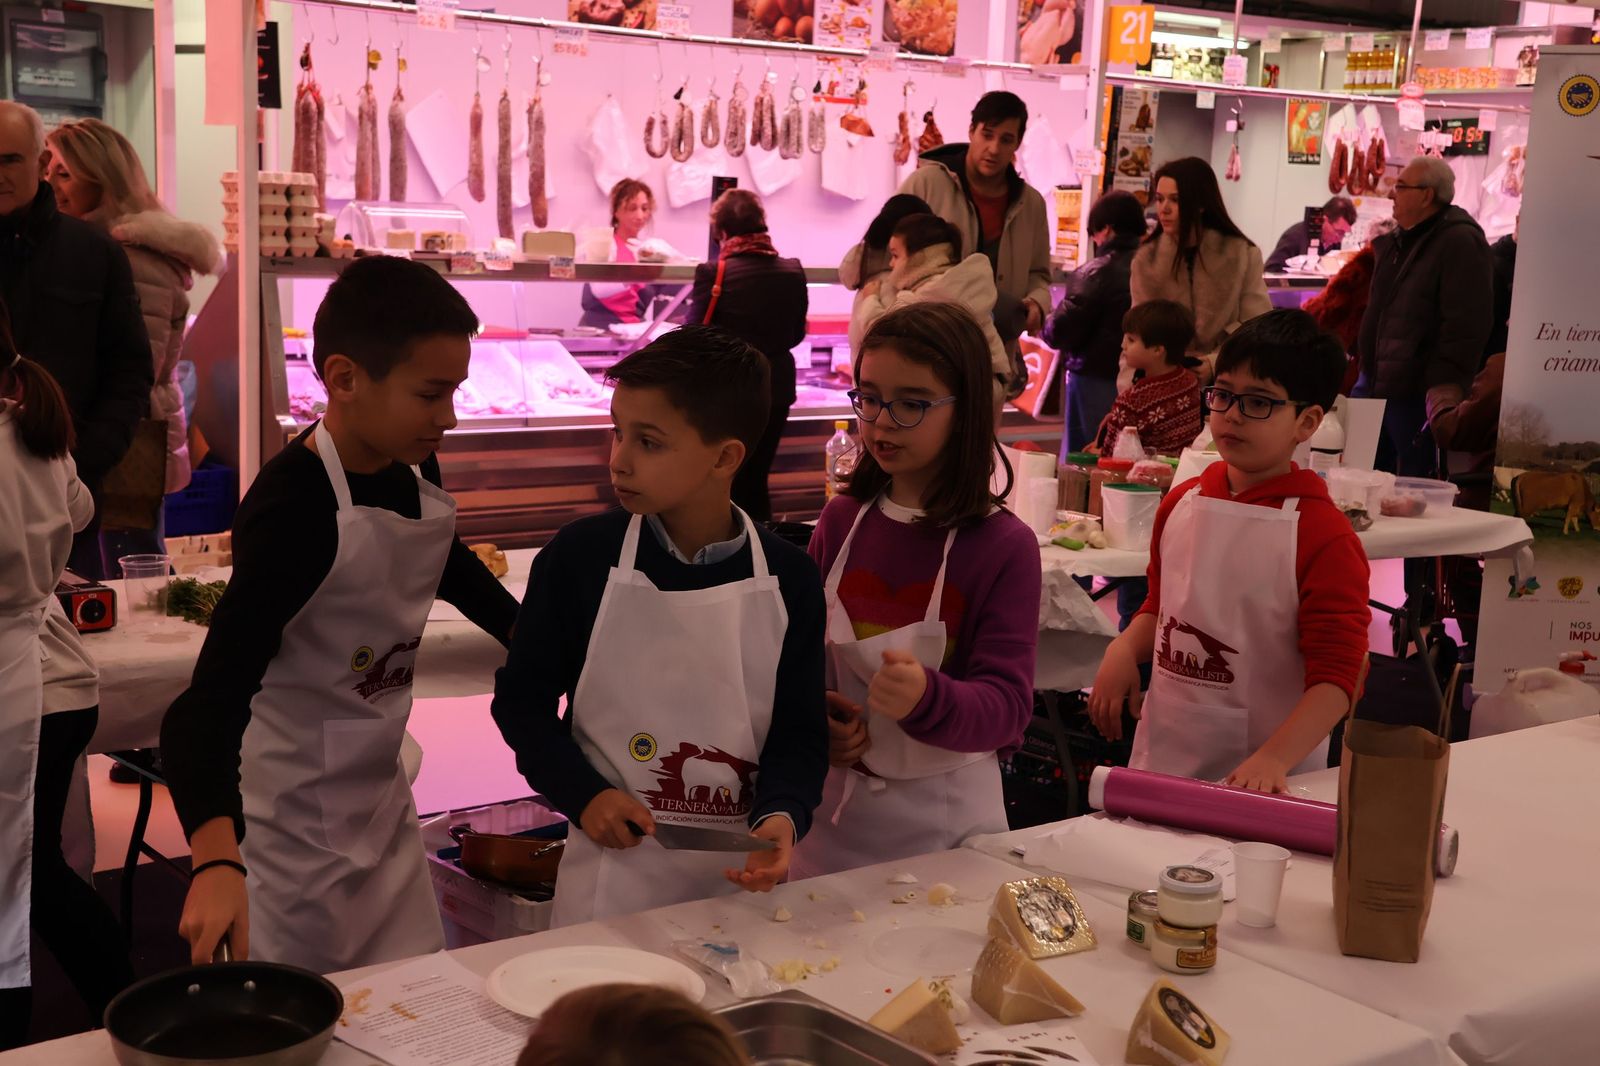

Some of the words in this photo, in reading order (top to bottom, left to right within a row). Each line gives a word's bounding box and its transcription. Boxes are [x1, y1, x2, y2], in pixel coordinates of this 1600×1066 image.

[1120, 11, 1147, 45] 21
[1536, 322, 1561, 340] En
[1566, 323, 1600, 341] tierr
[1543, 349, 1600, 372] criam
[1570, 621, 1592, 630] NOS
[1195, 668, 1228, 681] ALISTE
[658, 797, 718, 815] TERNERA
[656, 814, 692, 823] INDICACIÓN
